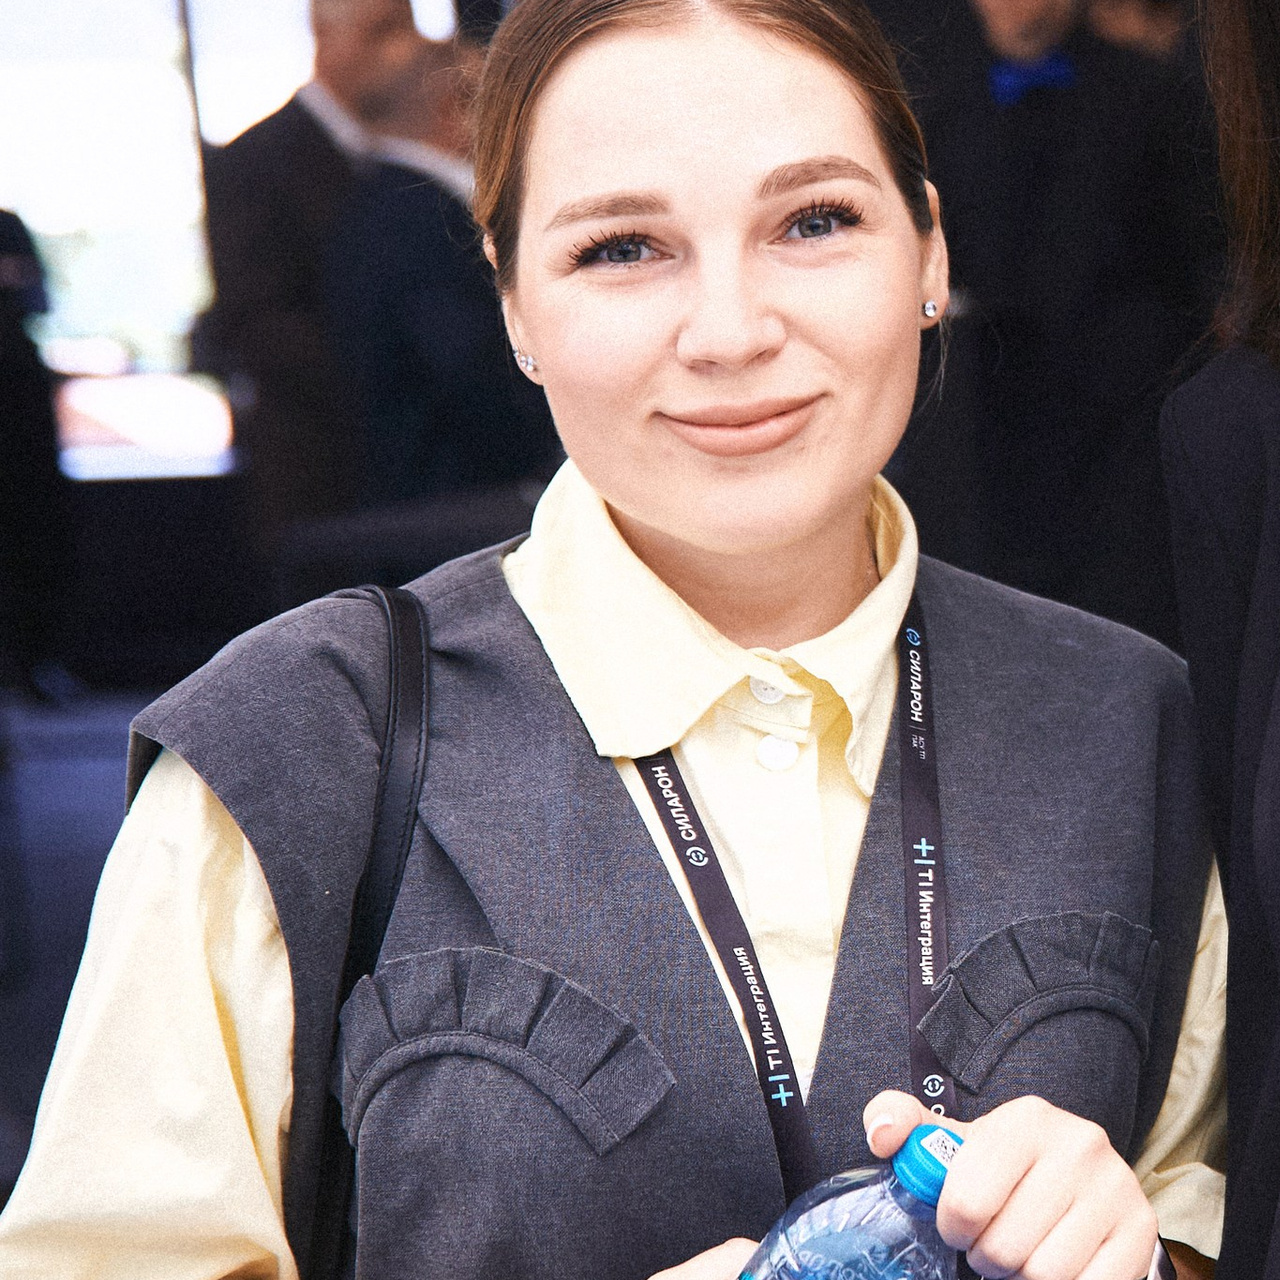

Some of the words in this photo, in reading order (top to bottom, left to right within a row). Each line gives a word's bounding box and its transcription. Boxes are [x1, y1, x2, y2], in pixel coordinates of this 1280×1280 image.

[909, 649, 923, 722] СИЛАРОН
[651, 765, 697, 841] СИЛАРОН
[917, 891, 934, 985] Интеграция
[733, 947, 777, 1045] Интеграция
